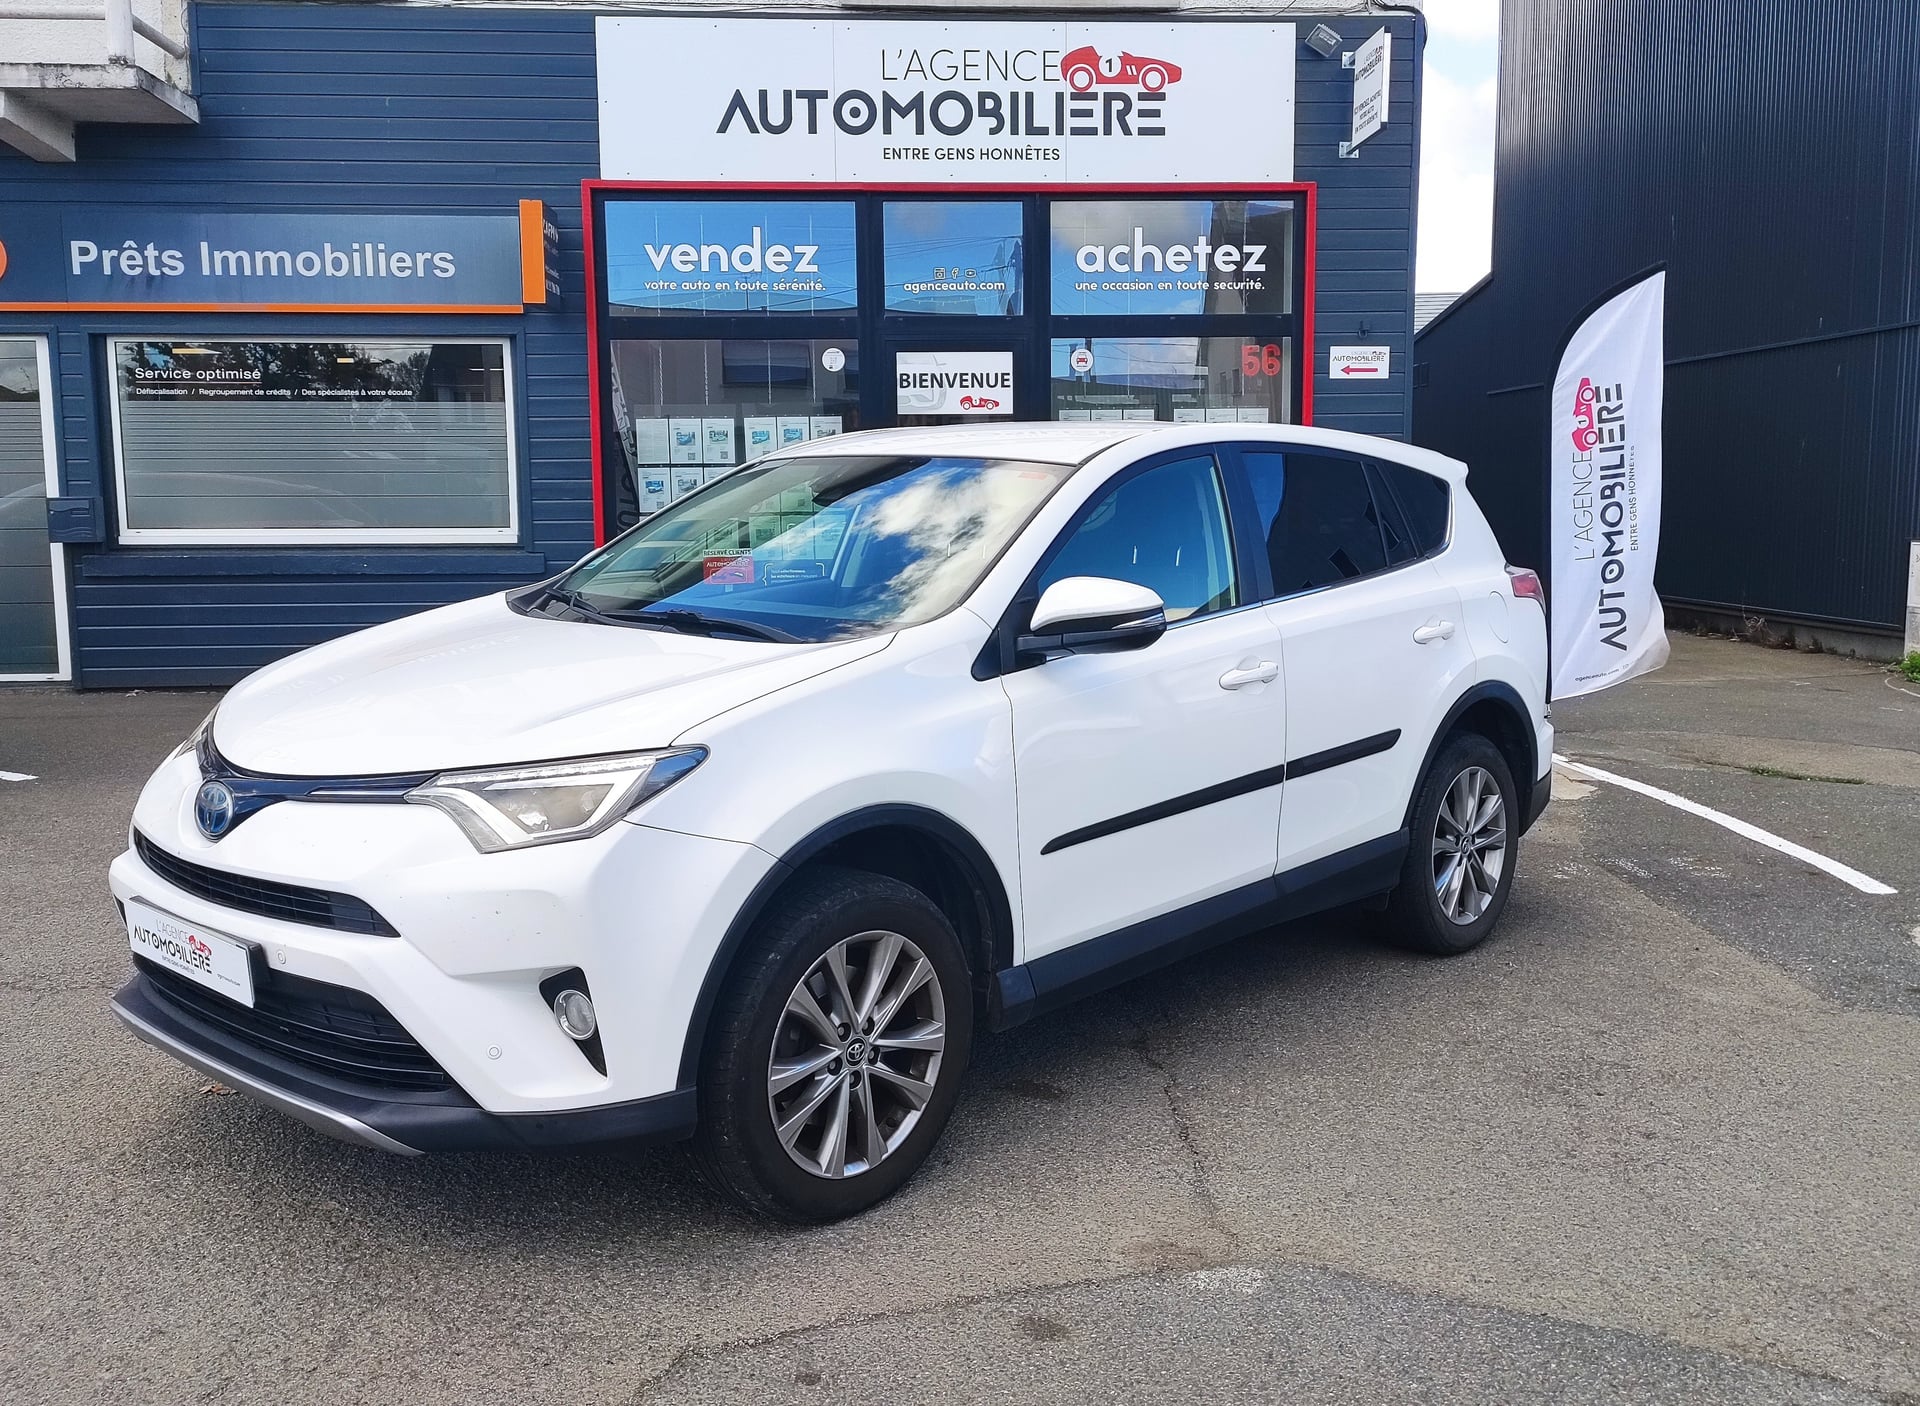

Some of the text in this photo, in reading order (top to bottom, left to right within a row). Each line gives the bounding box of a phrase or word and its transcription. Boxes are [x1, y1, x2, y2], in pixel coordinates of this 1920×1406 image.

[882, 48, 1060, 82] L'AGENCE
[1105, 58, 1113, 73] 1
[883, 144, 1060, 161] ENTRE GENS HONNÊTES
[643, 226, 819, 273] vendez
[1076, 227, 1267, 273] achetez
[70, 240, 456, 278] Prêts Immobiliers
[644, 278, 827, 291] votre auto en toute sérénité.
[903, 280, 1006, 294] agenceauto.com
[1075, 277, 1266, 291] une occasion en toute securité.
[1241, 344, 1281, 378] 56
[135, 367, 262, 382] Service optimisé
[899, 372, 1012, 389] BIENVENUE
[136, 387, 188, 396] Défiscalisation
[198, 388, 254, 397] Regroupement
[254, 388, 265, 396] de
[265, 388, 291, 397] crédits
[301, 388, 317, 396] Des
[317, 388, 360, 397] spécialistes
[360, 388, 367, 396] à
[387, 388, 413, 396] écoute
[1628, 497, 1638, 522] GENS
[1629, 523, 1639, 551] ENTRE
